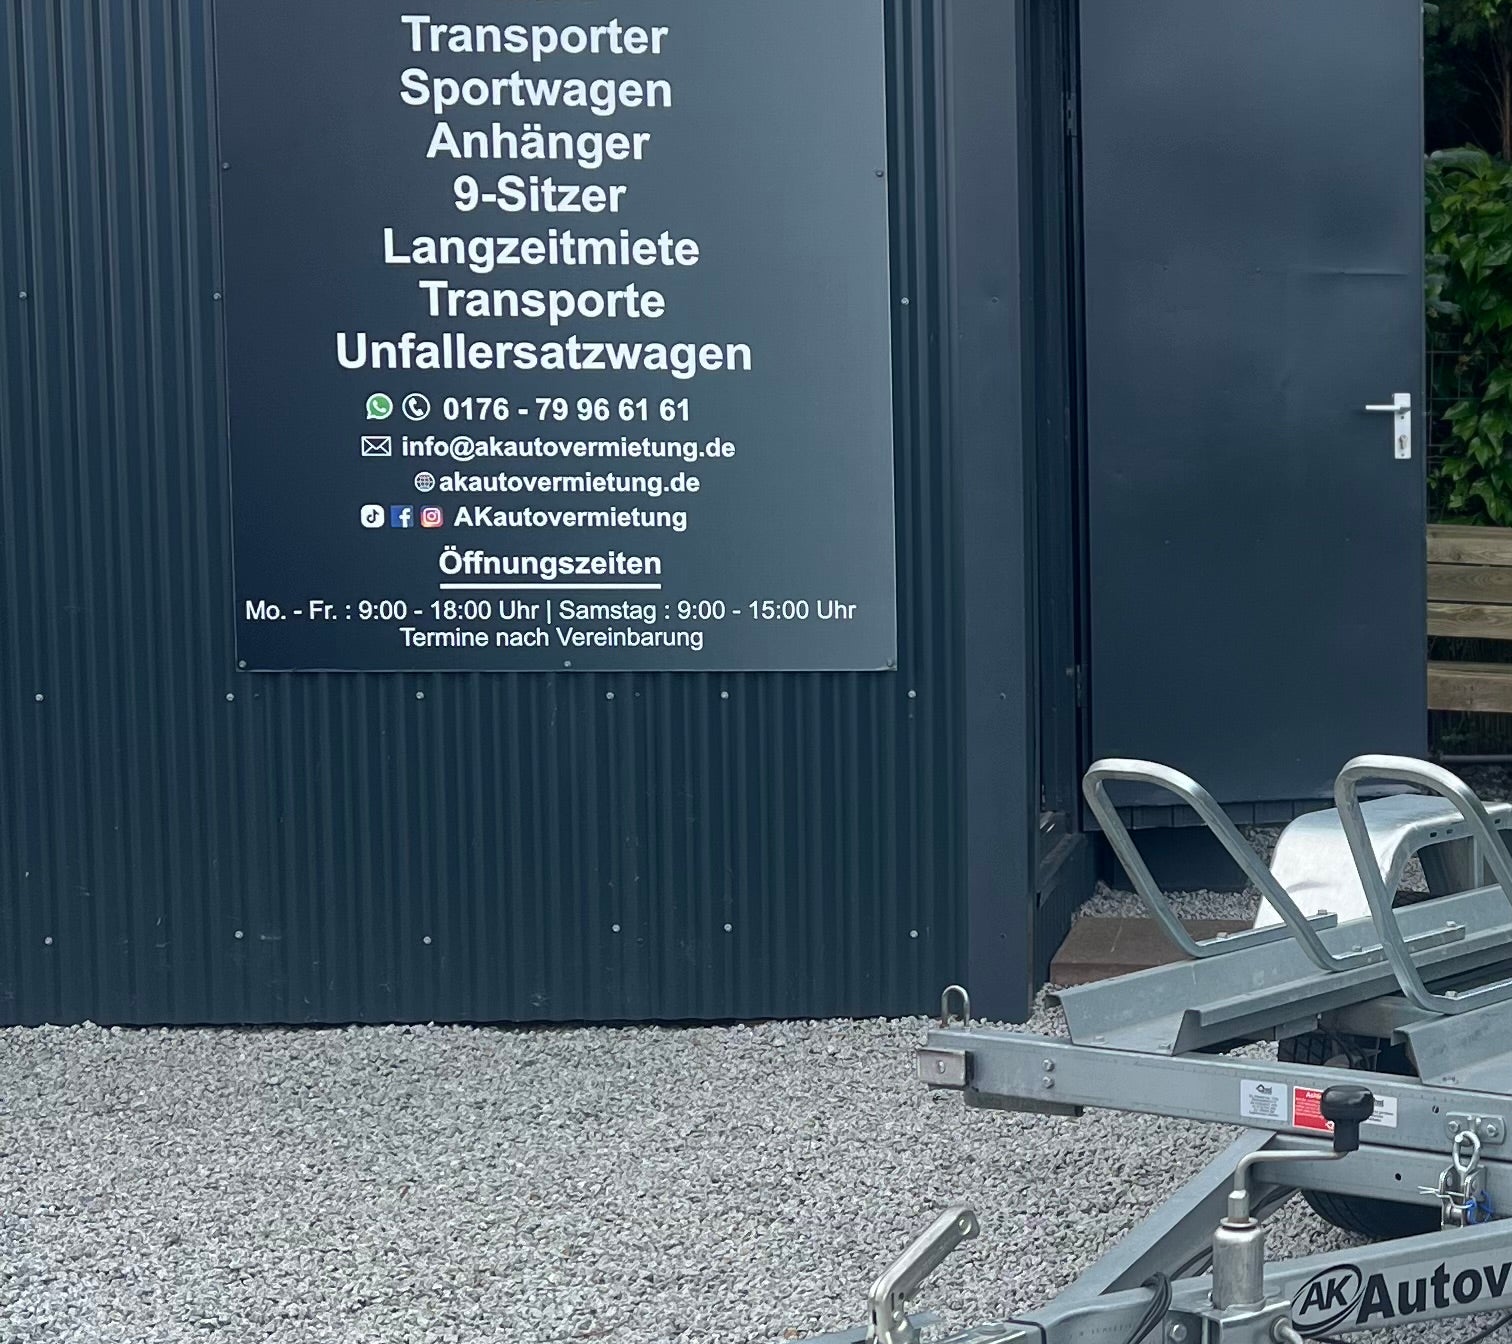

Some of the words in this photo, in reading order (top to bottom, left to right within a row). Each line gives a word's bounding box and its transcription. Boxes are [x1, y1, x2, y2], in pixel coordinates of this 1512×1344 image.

[400, 15, 669, 63] Transporter
[400, 67, 672, 117] Sportwagen
[426, 121, 651, 170] Anhänger
[453, 174, 627, 213] 9-Sitzer
[383, 227, 700, 274] Langzeitmiete
[418, 280, 666, 327] Transporte
[336, 332, 752, 380] Unfallersatzwagen
[443, 397, 510, 421] 0176
[535, 397, 569, 421] 79
[576, 397, 610, 421] 96
[618, 397, 648, 422] 61
[659, 398, 689, 422] 61
[402, 435, 736, 461] info@akautovermietung.de
[439, 471, 701, 497] akautovermietung.de
[453, 506, 687, 532] AKautovermietung
[439, 545, 662, 578] Öffnungszeiten
[245, 600, 287, 620] Mo.
[309, 599, 337, 620] Fr.
[358, 599, 407, 620] 9:00
[430, 599, 492, 620] 18:00
[499, 599, 540, 620] Uhr
[558, 599, 657, 626] Samstag
[677, 599, 726, 620] 9:00
[748, 599, 810, 620] 15:00
[816, 599, 857, 620] Uhr
[398, 627, 489, 647] Termine
[496, 626, 549, 647] nach
[555, 626, 704, 651] Vereinbarung
[1299, 1273, 1354, 1316] AK
